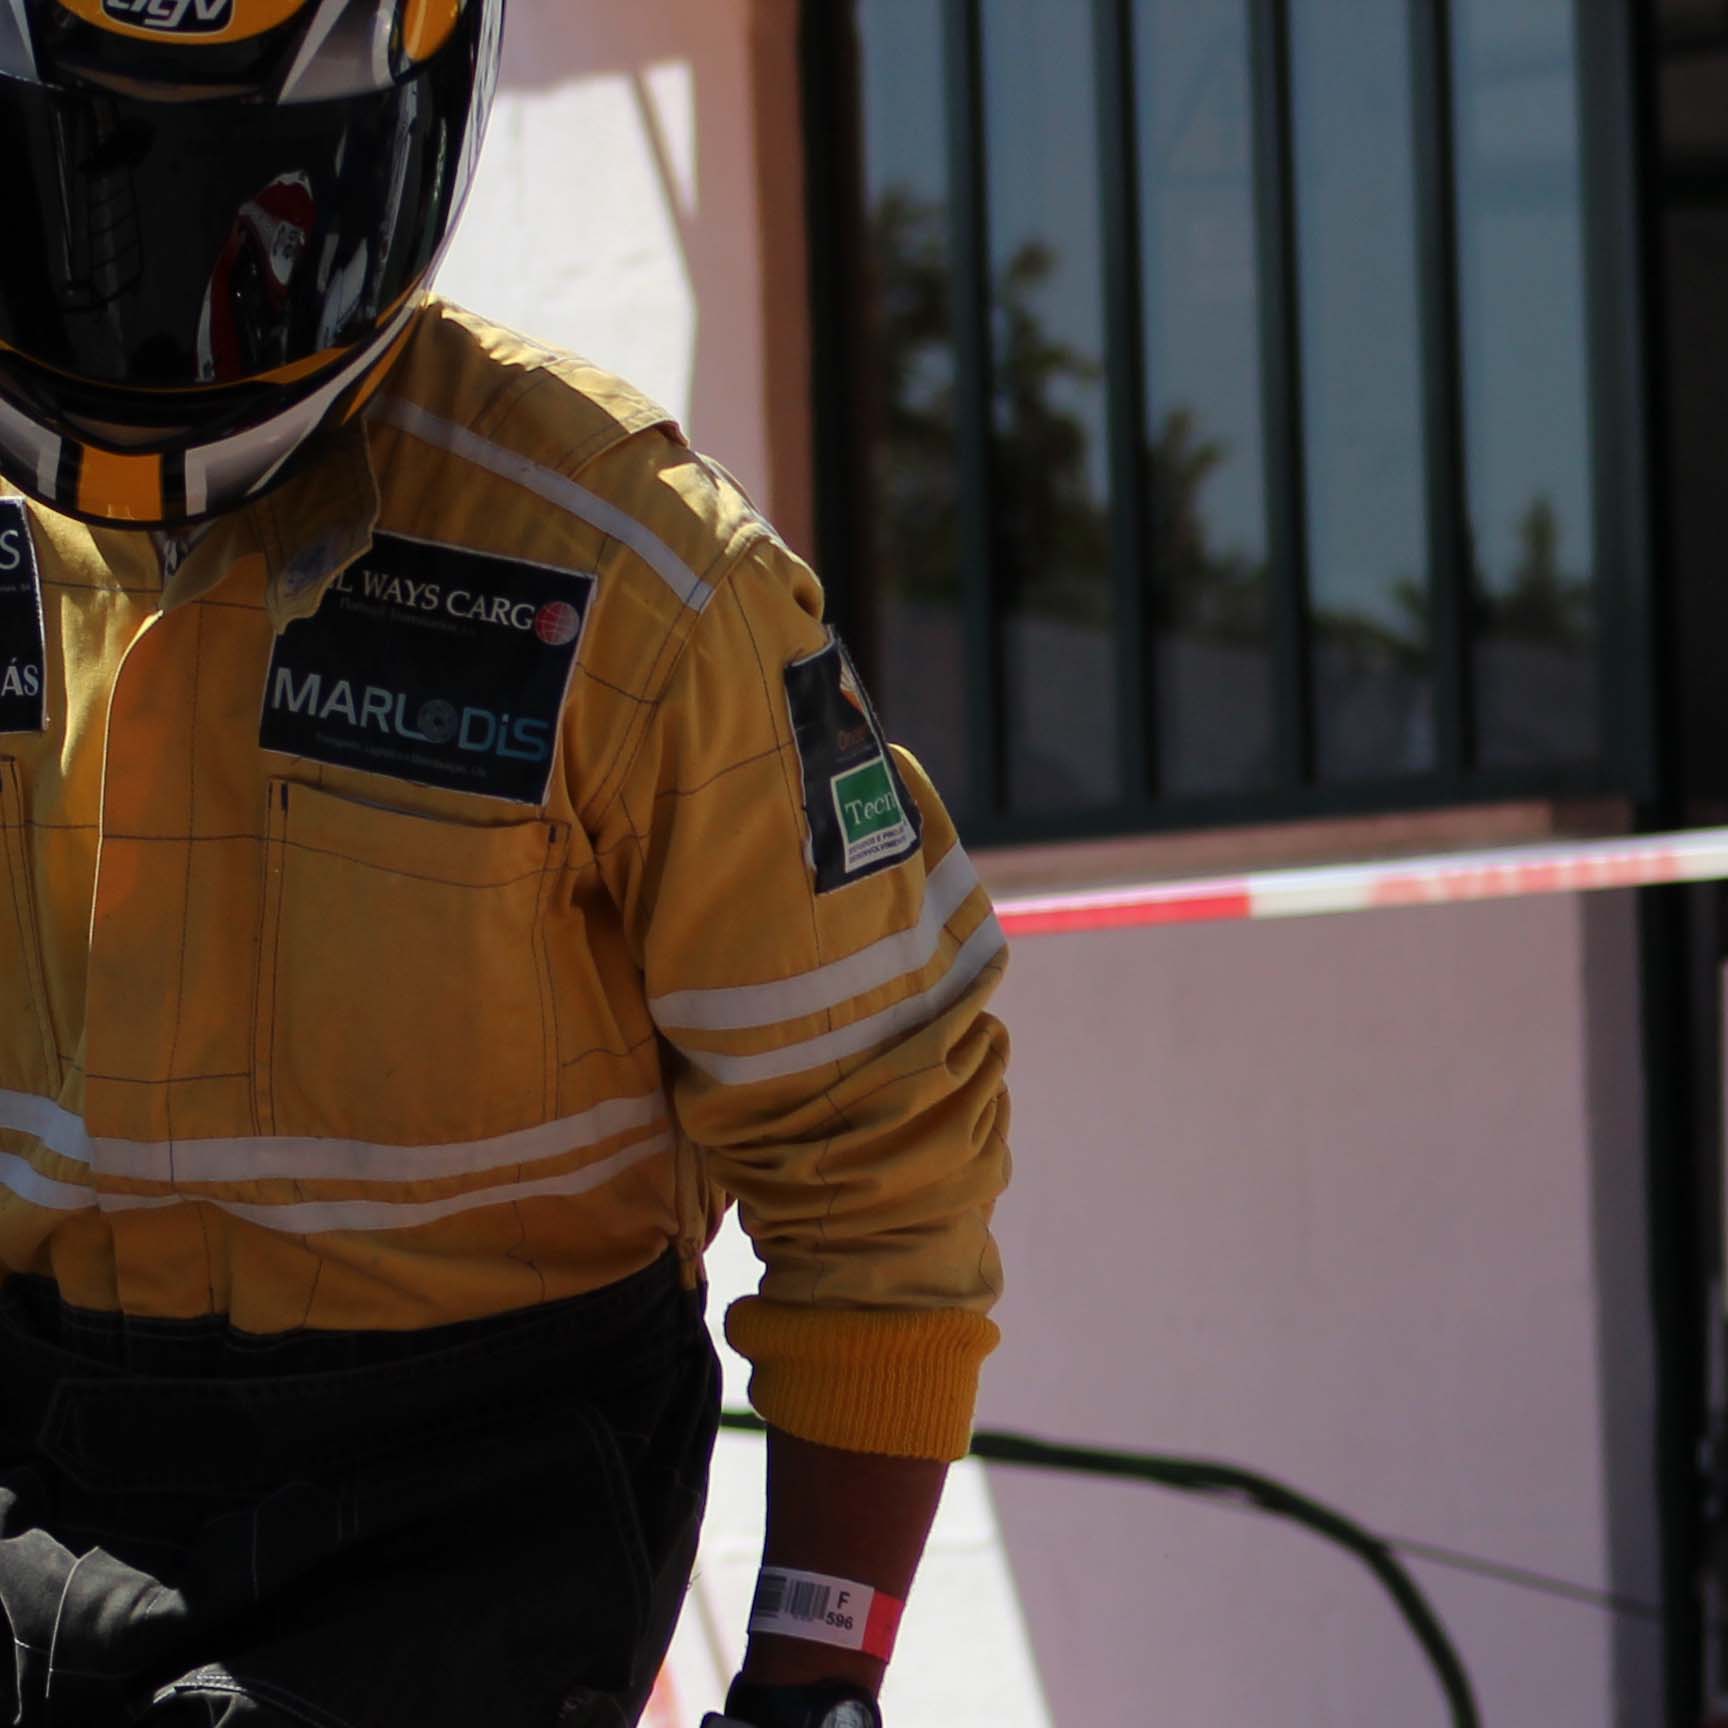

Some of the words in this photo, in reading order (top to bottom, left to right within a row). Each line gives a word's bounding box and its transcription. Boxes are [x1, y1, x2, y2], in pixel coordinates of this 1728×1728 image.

[362, 570, 439, 610] WAYS
[837, 1592, 850, 1609] F
[826, 1612, 853, 1630] 596
